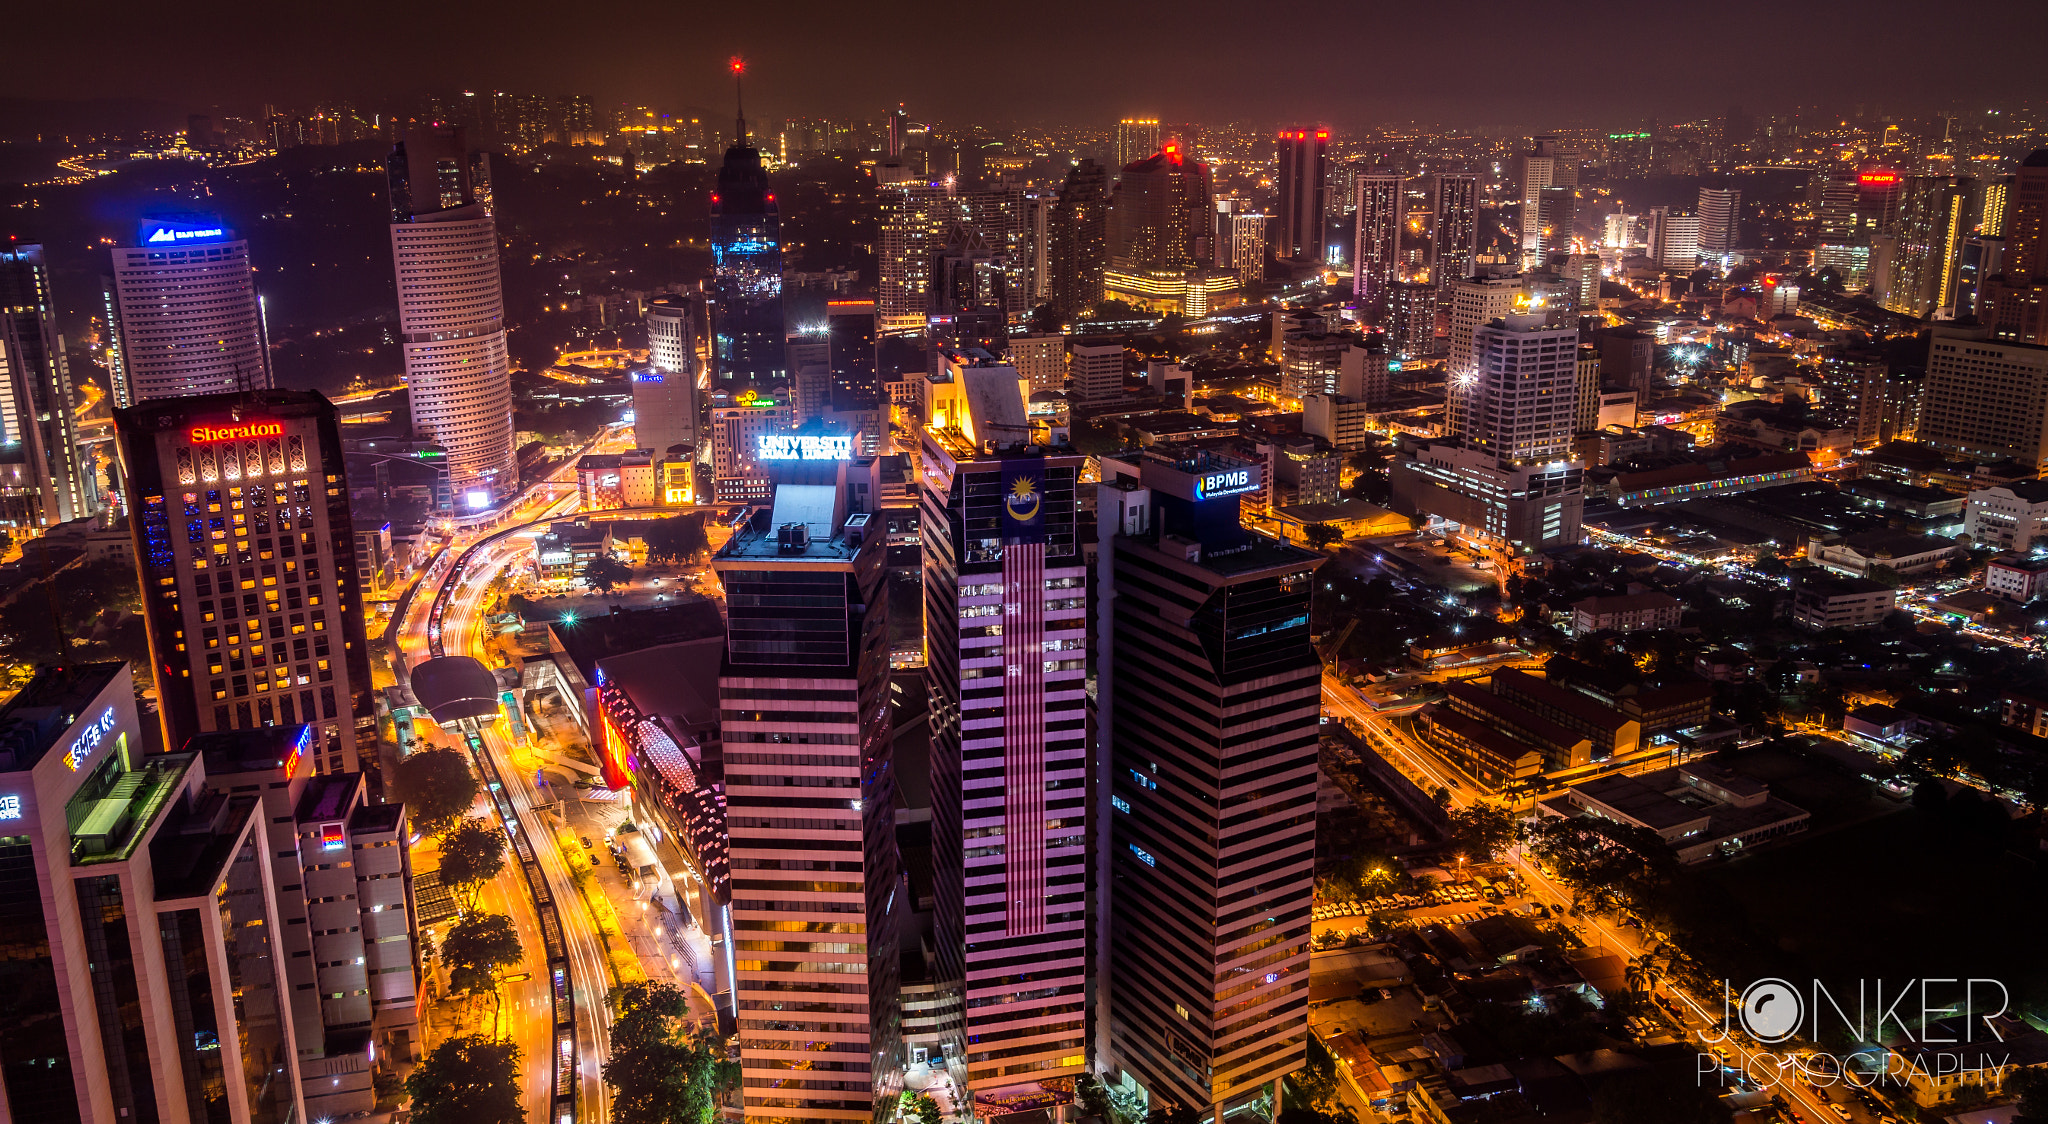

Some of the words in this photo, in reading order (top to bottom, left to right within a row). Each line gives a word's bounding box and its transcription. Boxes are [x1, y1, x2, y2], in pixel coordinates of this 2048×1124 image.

[192, 423, 282, 443] Sheraton
[758, 435, 852, 449] UNIVERSITI
[758, 448, 800, 460] KUALA
[801, 448, 852, 460] LUMPUR
[1206, 470, 1249, 491] BPMB
